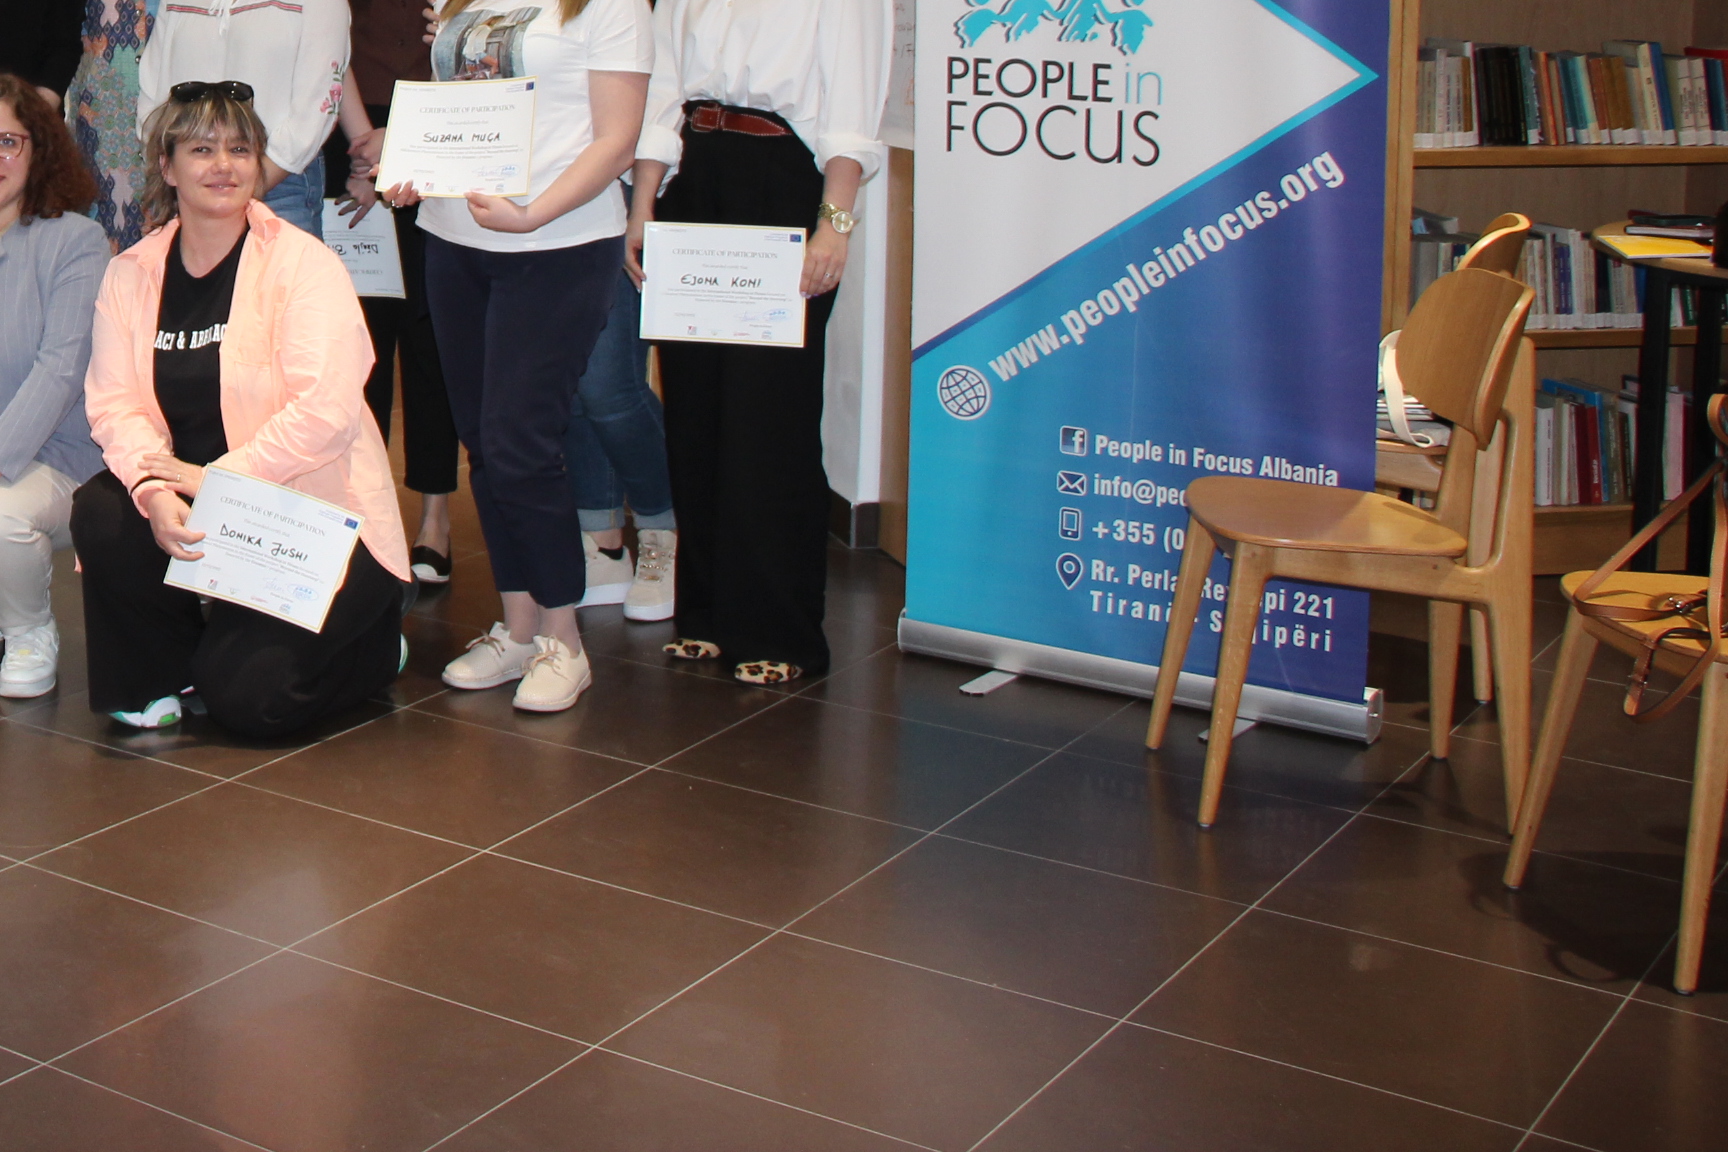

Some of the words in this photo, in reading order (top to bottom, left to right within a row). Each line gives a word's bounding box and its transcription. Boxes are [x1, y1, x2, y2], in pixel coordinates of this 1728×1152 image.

[946, 56, 1114, 103] PEOPLE
[1124, 62, 1163, 105] in
[946, 100, 1161, 167] FOCUS
[988, 151, 1346, 382] www.peopleinfocus.org
[153, 330, 175, 350] ACI
[1095, 434, 1162, 463] People
[1168, 444, 1186, 466] in
[1193, 448, 1253, 475] Focus
[1259, 456, 1339, 487] Albania
[1092, 519, 1155, 545] +355
[1163, 527, 1185, 550] (0
[1091, 559, 1119, 584] Rr.
[1127, 564, 1179, 592] Perla
[1201, 577, 1286, 614] Repi
[1293, 591, 1335, 620] 221
[1209, 610, 1332, 652] Sipëri
